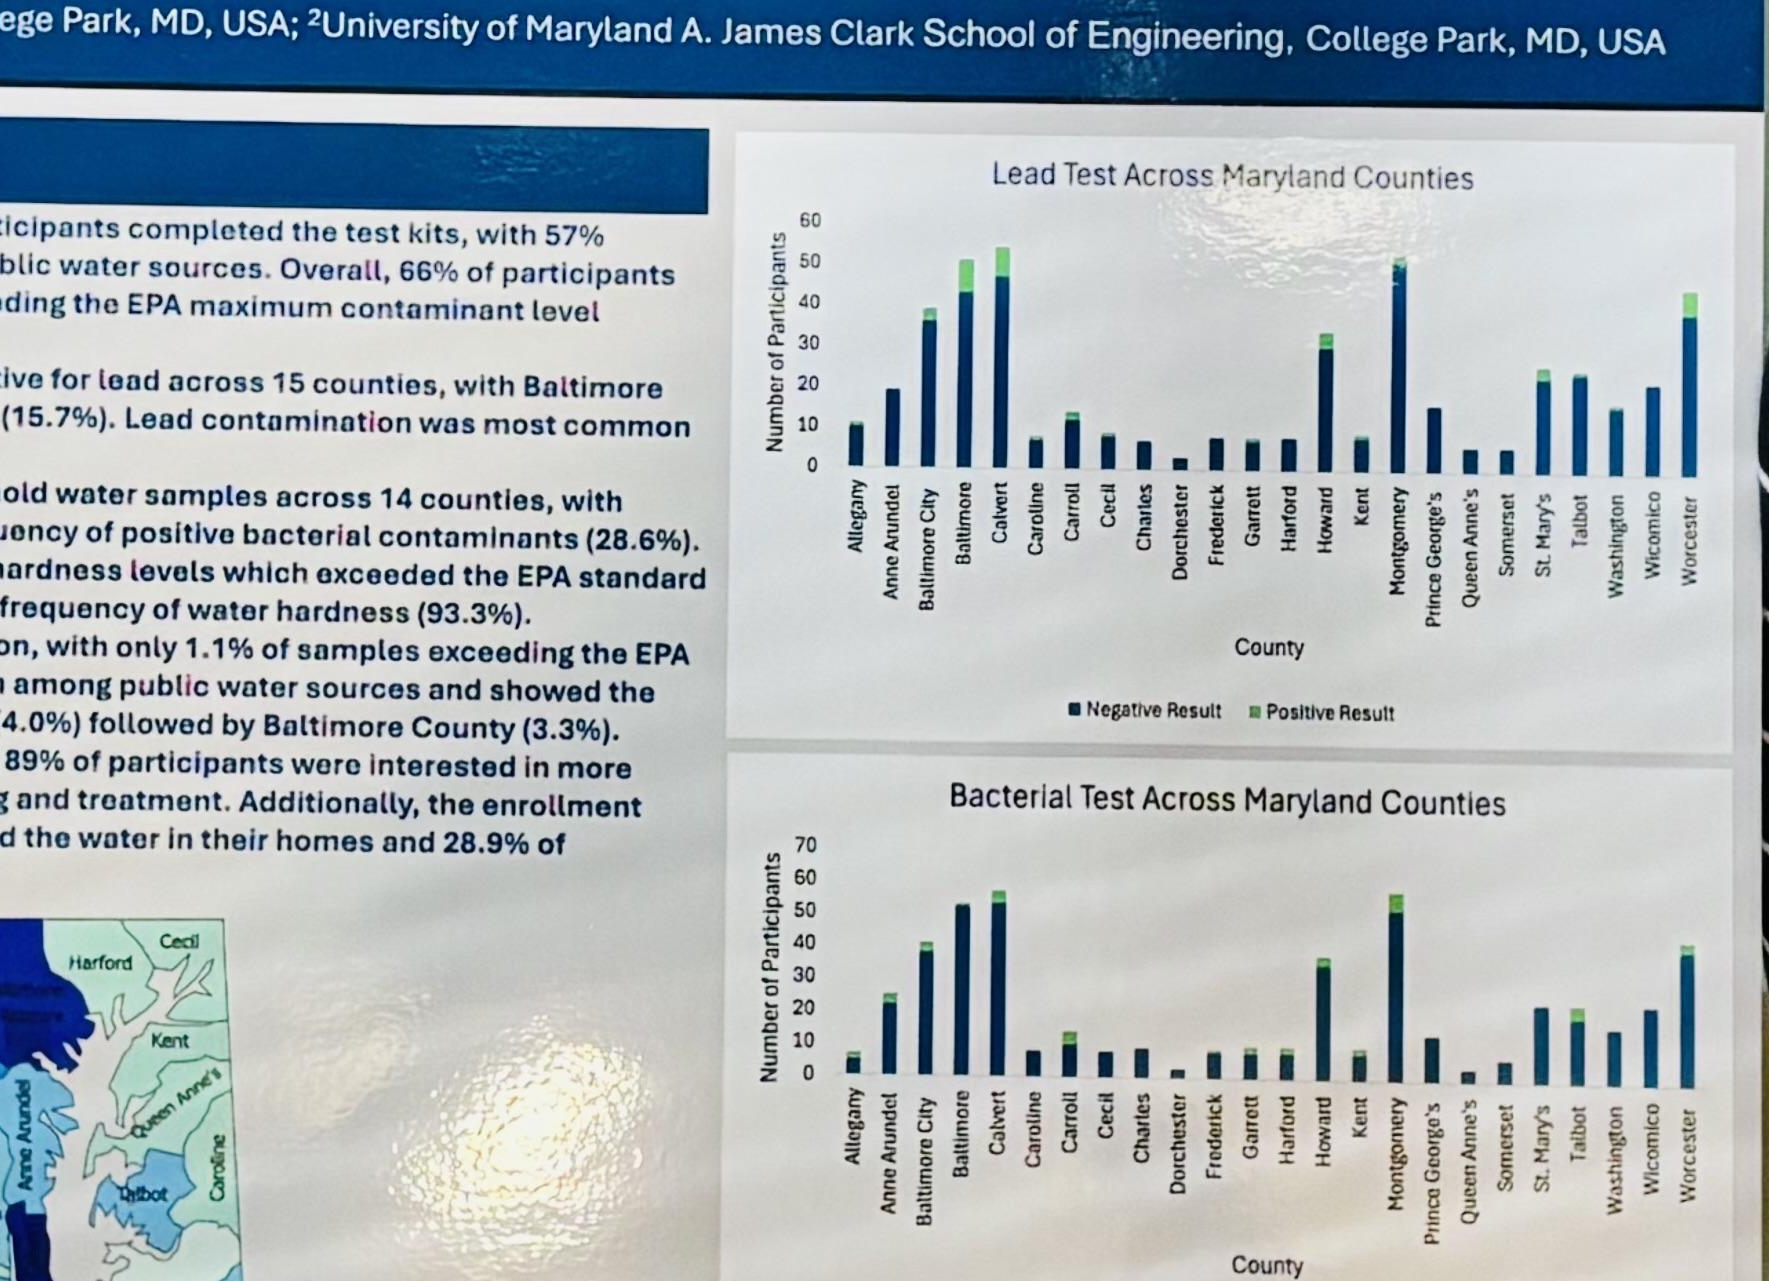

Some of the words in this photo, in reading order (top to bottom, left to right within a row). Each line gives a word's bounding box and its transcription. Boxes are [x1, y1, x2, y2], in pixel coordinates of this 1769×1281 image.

[993, 161, 1056, 186] Lead
[1063, 161, 1117, 187] Test
[1123, 162, 1214, 188] Across
[1222, 163, 1345, 194] Maryland
[1353, 164, 1474, 191] Counties
[768, 232, 788, 347] Participants
[767, 353, 785, 372] of
[766, 375, 785, 453] Number
[992, 481, 1007, 543] Calvert
[1028, 483, 1043, 555] Caroline
[1064, 483, 1079, 541] Carroll
[1137, 483, 1152, 551] Charles
[1209, 484, 1224, 565] Frederick
[1318, 487, 1333, 554] Howard
[1355, 488, 1370, 526] Kent
[1390, 487, 1410, 596] Montgomery
[1645, 491, 1661, 579] Wicomico
[1234, 636, 1305, 661] County
[1087, 700, 1163, 722] Negative
[1167, 701, 1222, 720] Result
[1266, 702, 1335, 721] Positive
[1338, 703, 1395, 722] Result
[950, 781, 1072, 810] Bacterial
[1079, 784, 1135, 810] Test
[1142, 785, 1236, 813] Across
[1244, 786, 1372, 819] Maryland
[1381, 788, 1506, 817] Counties
[160, 934, 199, 949] Cecil
[69, 956, 132, 971] Harford
[151, 1032, 189, 1048] Kent
[1231, 1254, 1304, 1280] County
